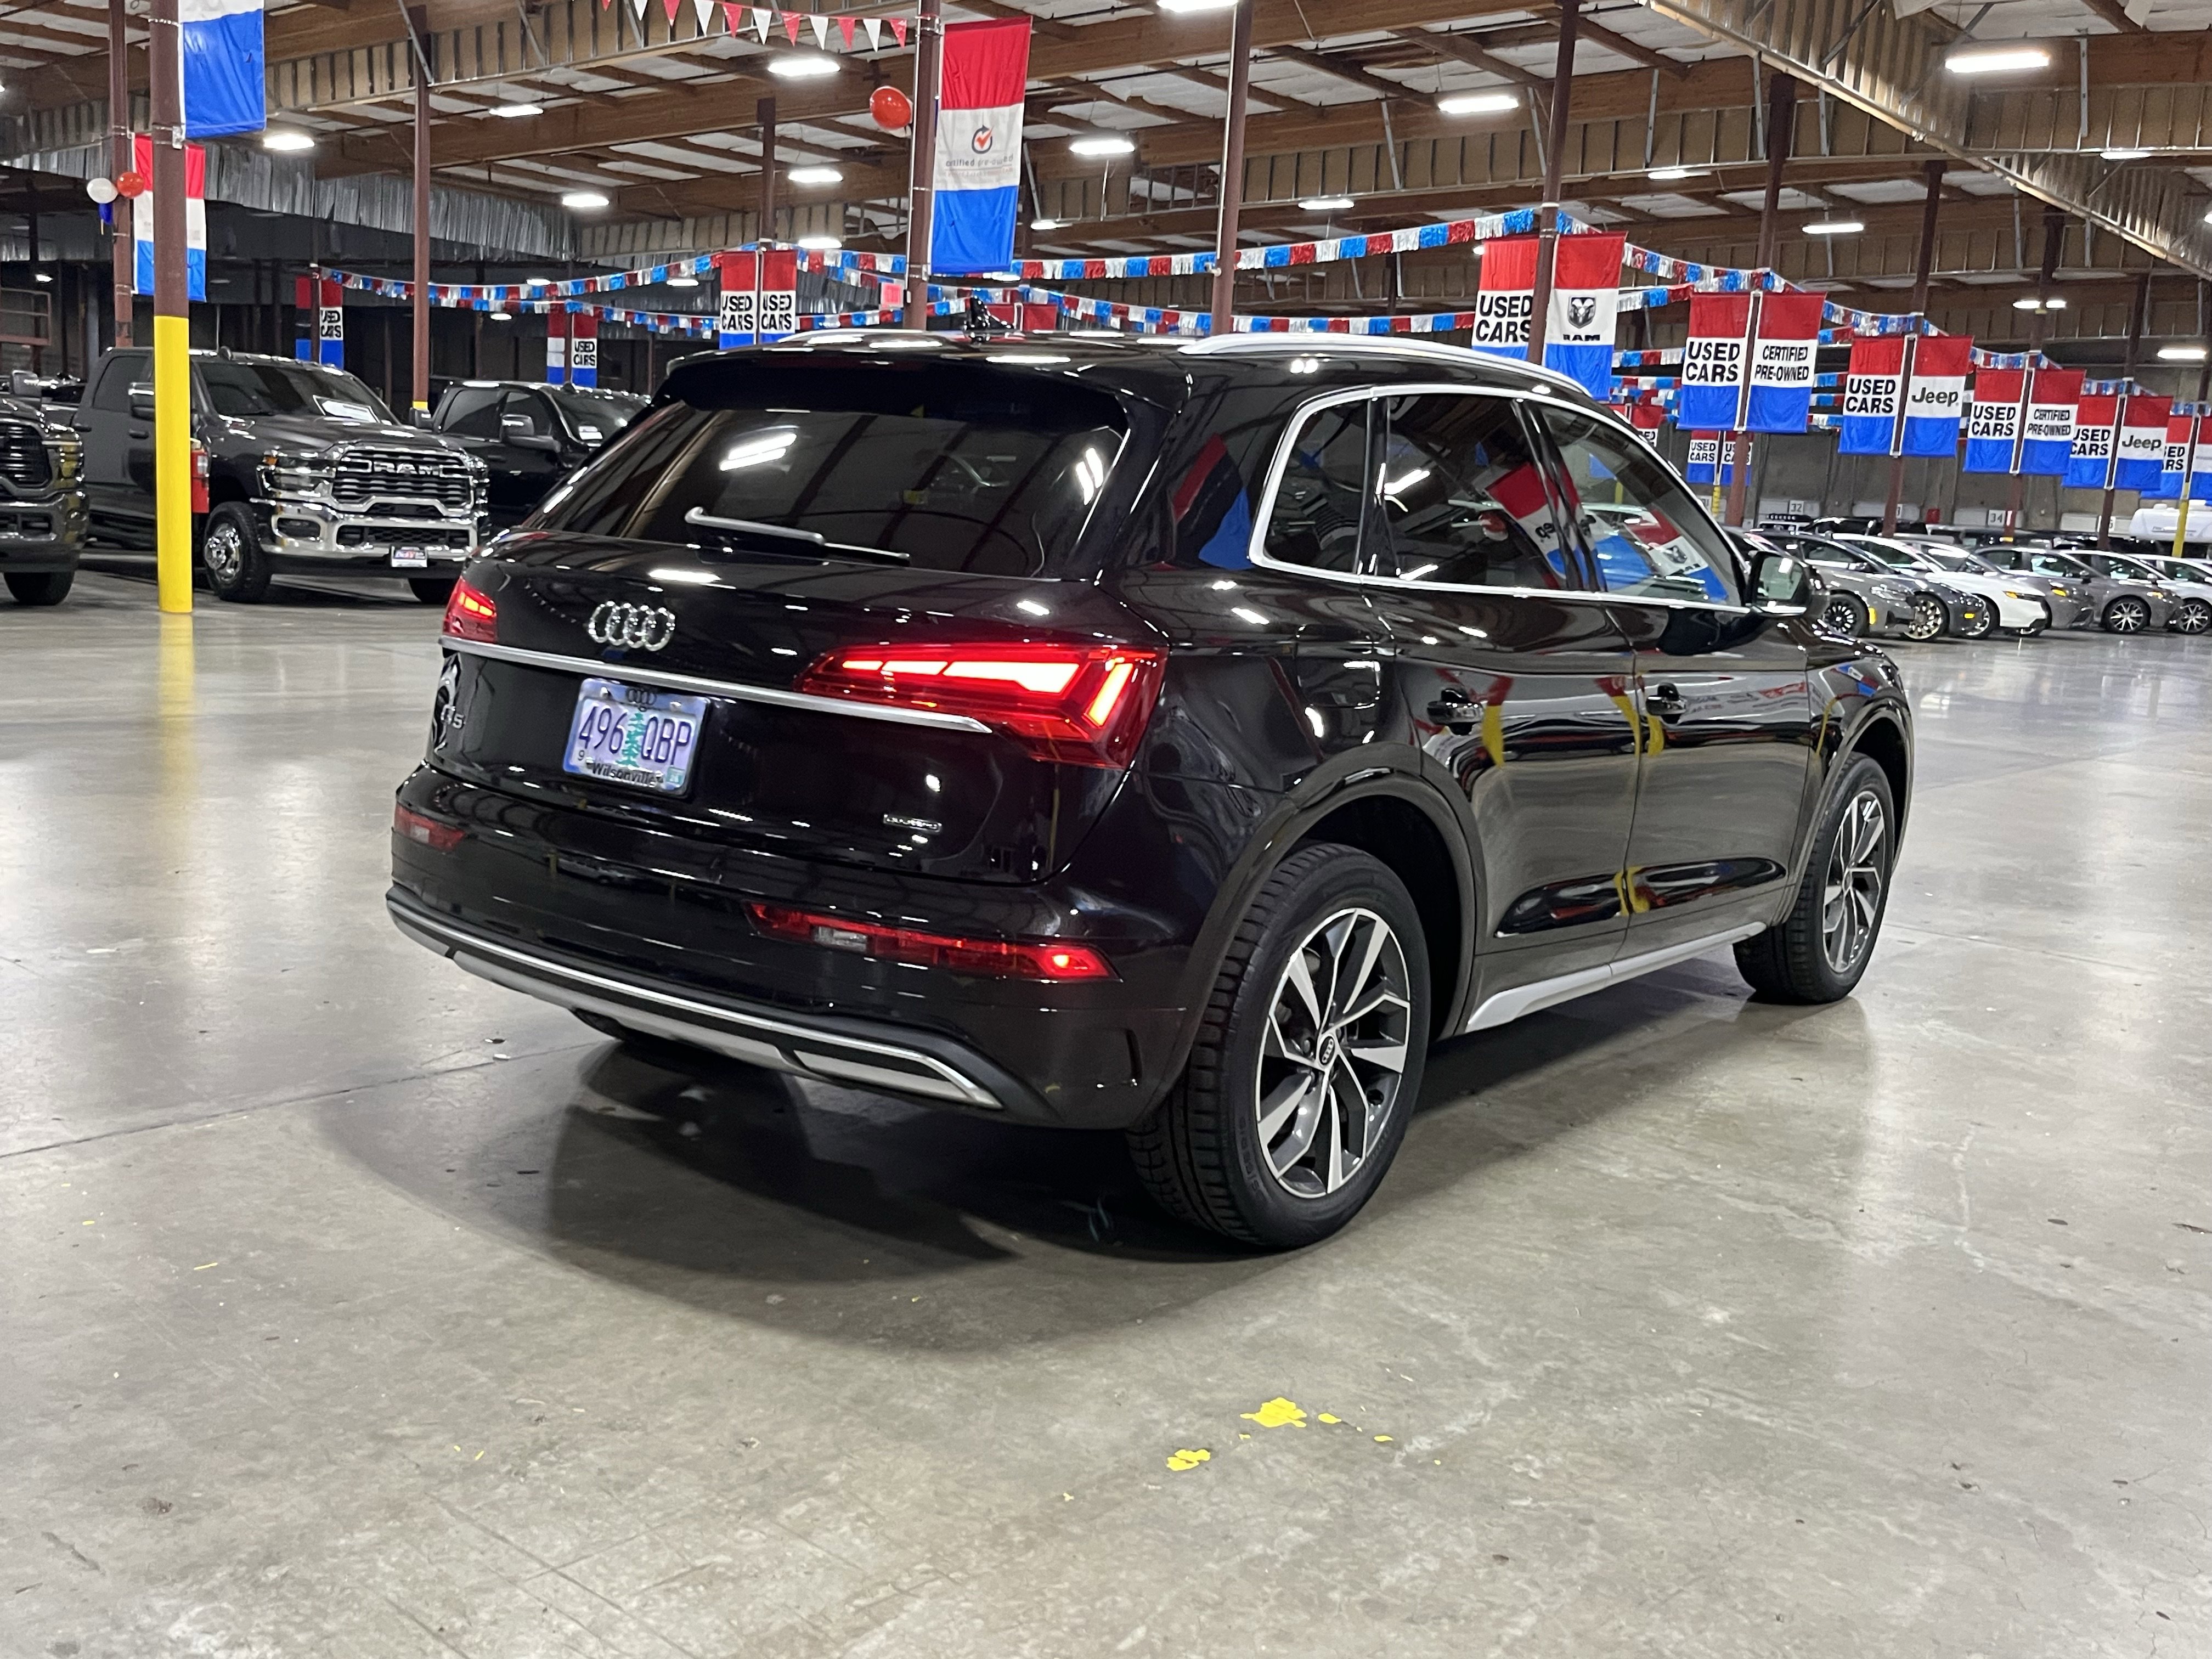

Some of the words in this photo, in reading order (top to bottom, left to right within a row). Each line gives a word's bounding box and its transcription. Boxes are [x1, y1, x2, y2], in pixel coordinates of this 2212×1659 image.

[722, 295, 752, 312] USED
[763, 295, 792, 311] USED
[1480, 295, 1533, 318] USED
[721, 314, 753, 330] CARS
[761, 313, 792, 330] CARS
[1476, 319, 1531, 343] CARS
[1688, 341, 1740, 362] USED
[1763, 345, 1808, 362] CERTIFIED
[1686, 362, 1738, 382] CARS
[1754, 364, 1809, 381] PRE-OWNED
[1849, 379, 1895, 395] USED
[1846, 396, 1893, 413] CARS
[1911, 387, 1959, 407] Jeep
[1973, 405, 2016, 421] USED
[1972, 421, 2014, 437] CARS
[1691, 442, 1716, 452] USED
[2122, 435, 2162, 451] Jeep
[1690, 452, 1715, 462] CARS
[1790, 503, 1802, 512] 32
[1990, 513, 2002, 523] 34
[579, 706, 627, 754] 496
[641, 716, 691, 765] QBP
[578, 750, 585, 761] 9
